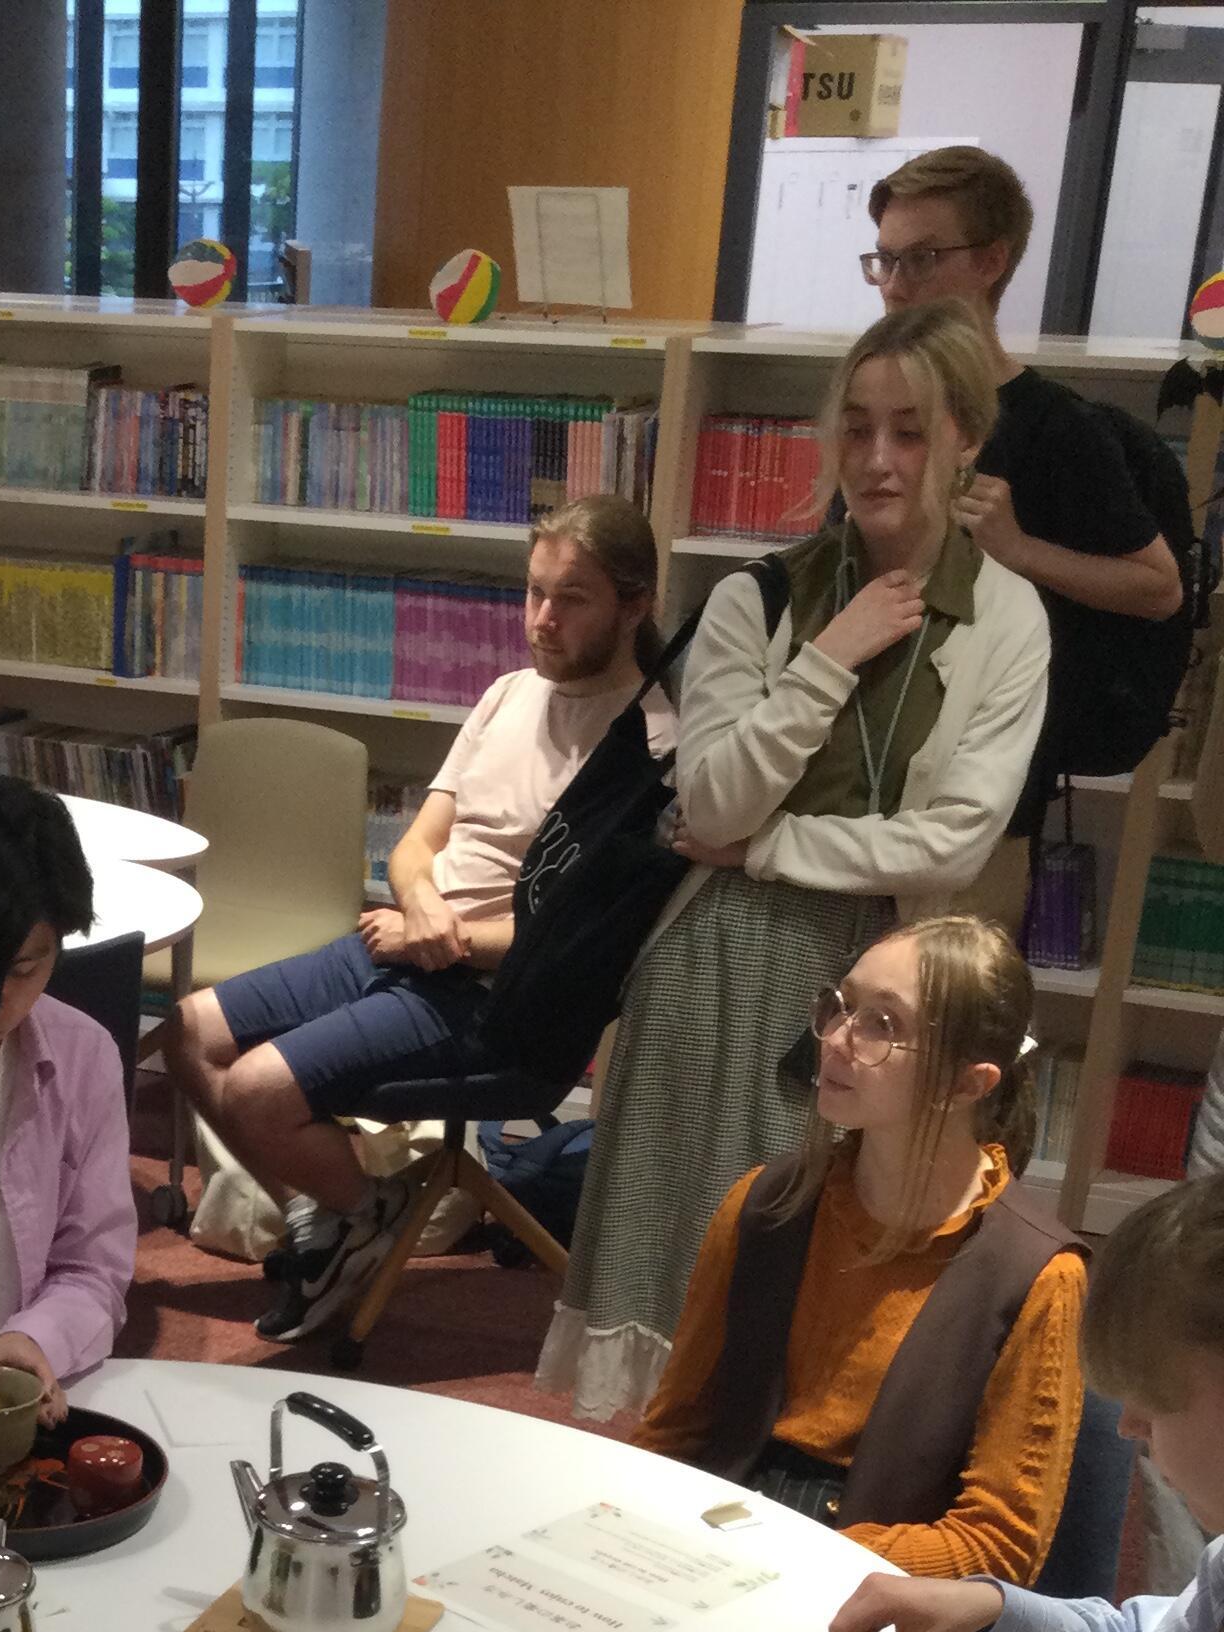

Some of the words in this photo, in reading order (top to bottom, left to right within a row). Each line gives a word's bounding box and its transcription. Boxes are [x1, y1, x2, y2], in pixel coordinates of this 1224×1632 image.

[484, 1566, 537, 1590] Matcha
[569, 1604, 592, 1614] to
[587, 1611, 626, 1629] How
